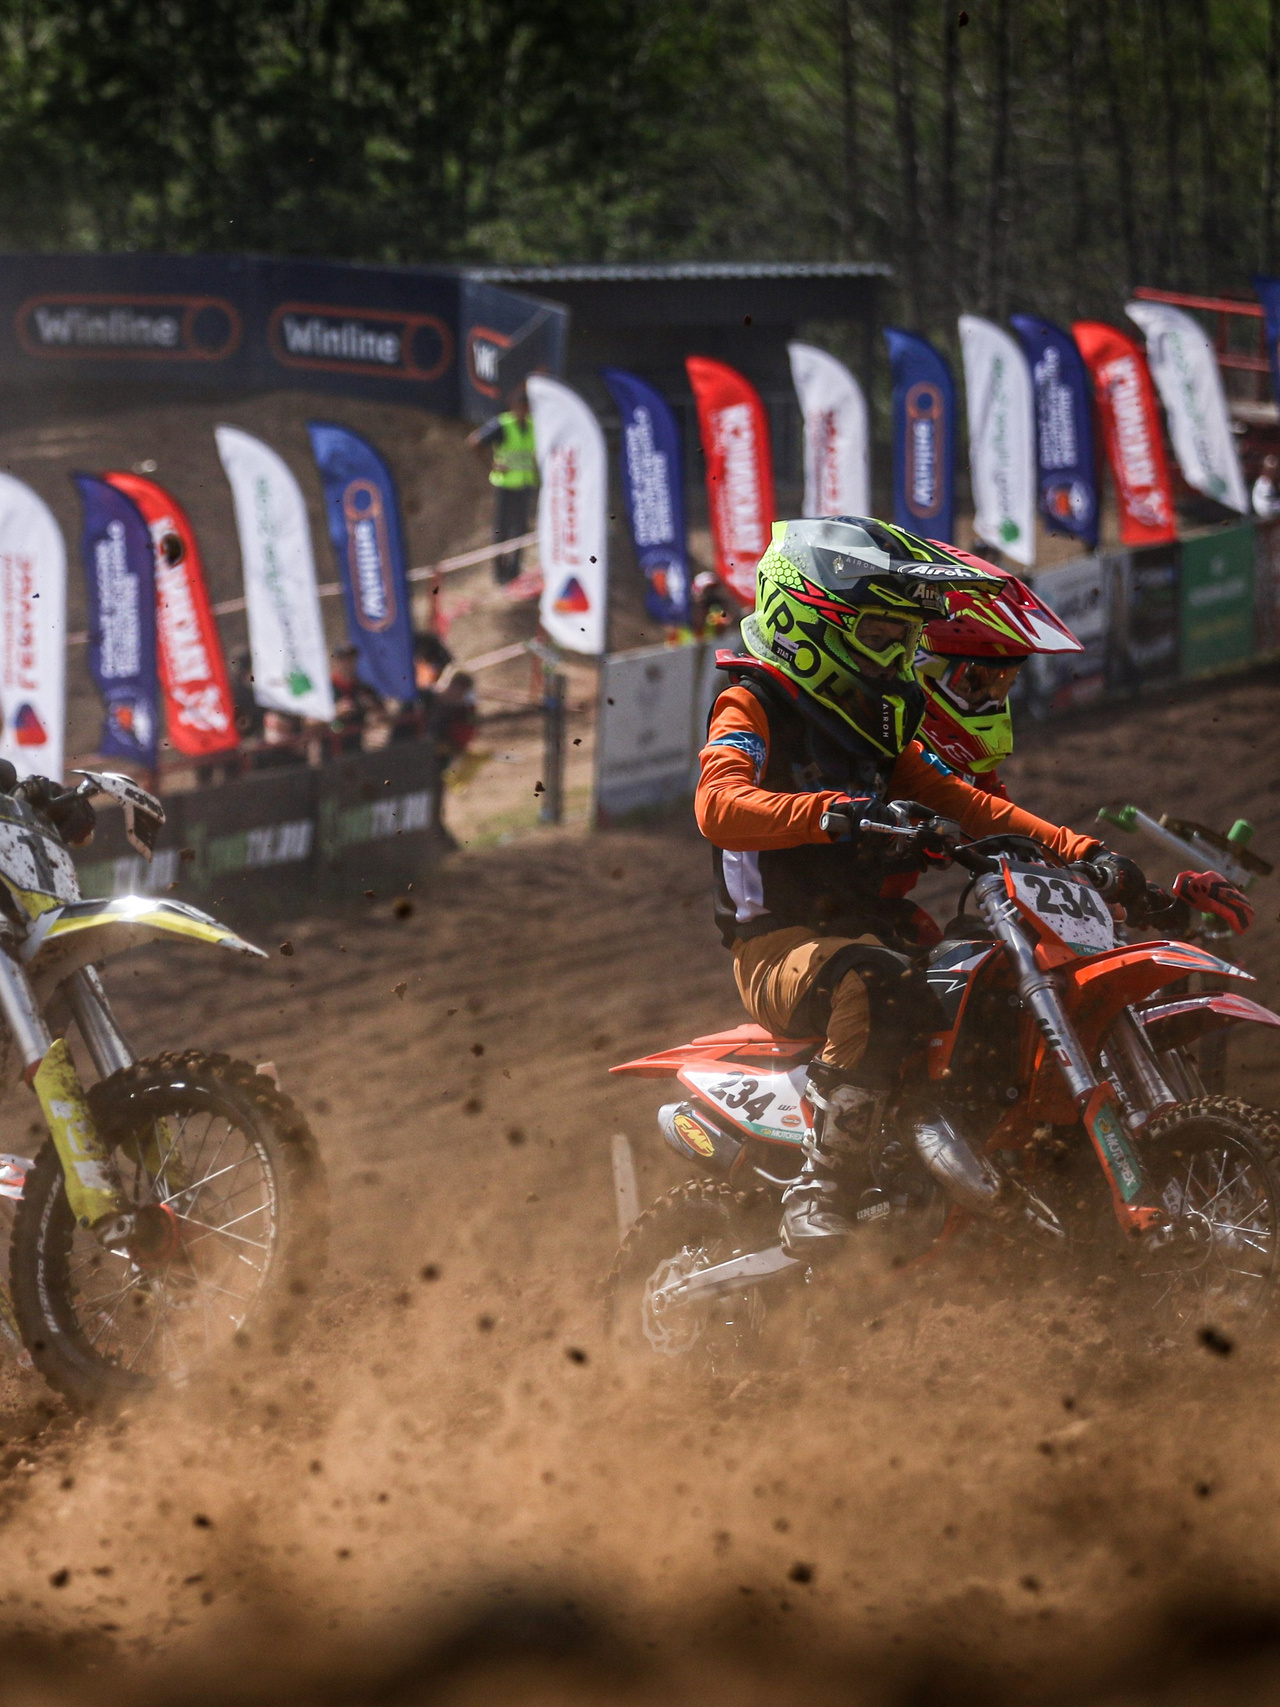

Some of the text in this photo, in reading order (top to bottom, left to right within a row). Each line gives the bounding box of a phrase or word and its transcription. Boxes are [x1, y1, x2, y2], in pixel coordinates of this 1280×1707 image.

[34, 307, 180, 347] Winline
[283, 318, 401, 364] Winline
[845, 557, 876, 571] AIROH
[908, 565, 972, 577] Airoh
[882, 703, 890, 738] AIROH
[1023, 874, 1107, 928] 234
[708, 1071, 777, 1123] 234
[674, 1115, 715, 1155] FMF
[1104, 1132, 1137, 1187] MOTOREX
